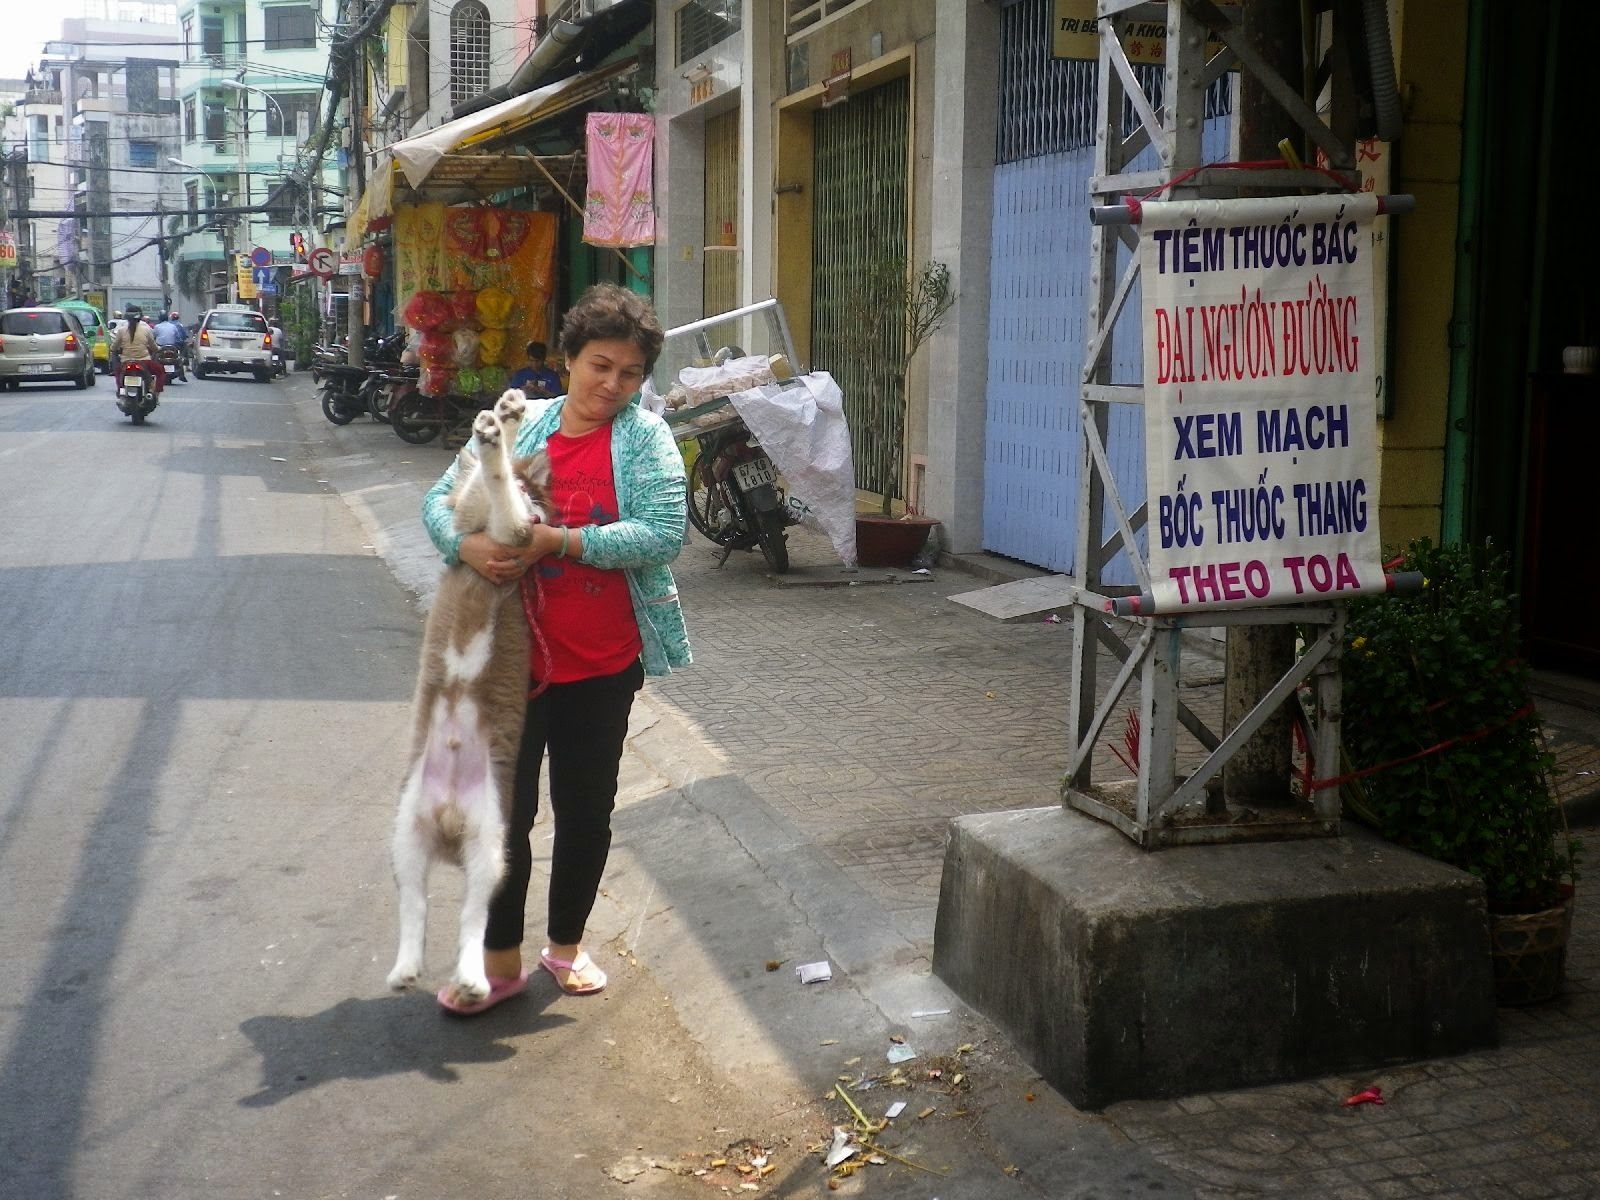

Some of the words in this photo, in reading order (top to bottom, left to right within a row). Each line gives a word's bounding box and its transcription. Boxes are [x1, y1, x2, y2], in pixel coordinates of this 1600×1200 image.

[1061, 17, 1080, 34] TRỊ
[1154, 218, 1225, 287] TIỆM
[1230, 209, 1307, 269] THUỐC
[1312, 204, 1357, 265] BẮC
[1155, 308, 1195, 403] ĐẠI
[1200, 286, 1276, 381] NGƯƠN
[1281, 274, 1359, 376] ĐƯỜNG
[1174, 412, 1242, 460] XEM
[1258, 405, 1348, 464] MẠCH
[1160, 474, 1203, 548] BỐC
[1212, 468, 1284, 544] THUỐC
[1294, 479, 1366, 536] THANG
[1169, 560, 1270, 604] THEO
[1283, 553, 1360, 594] TOA
